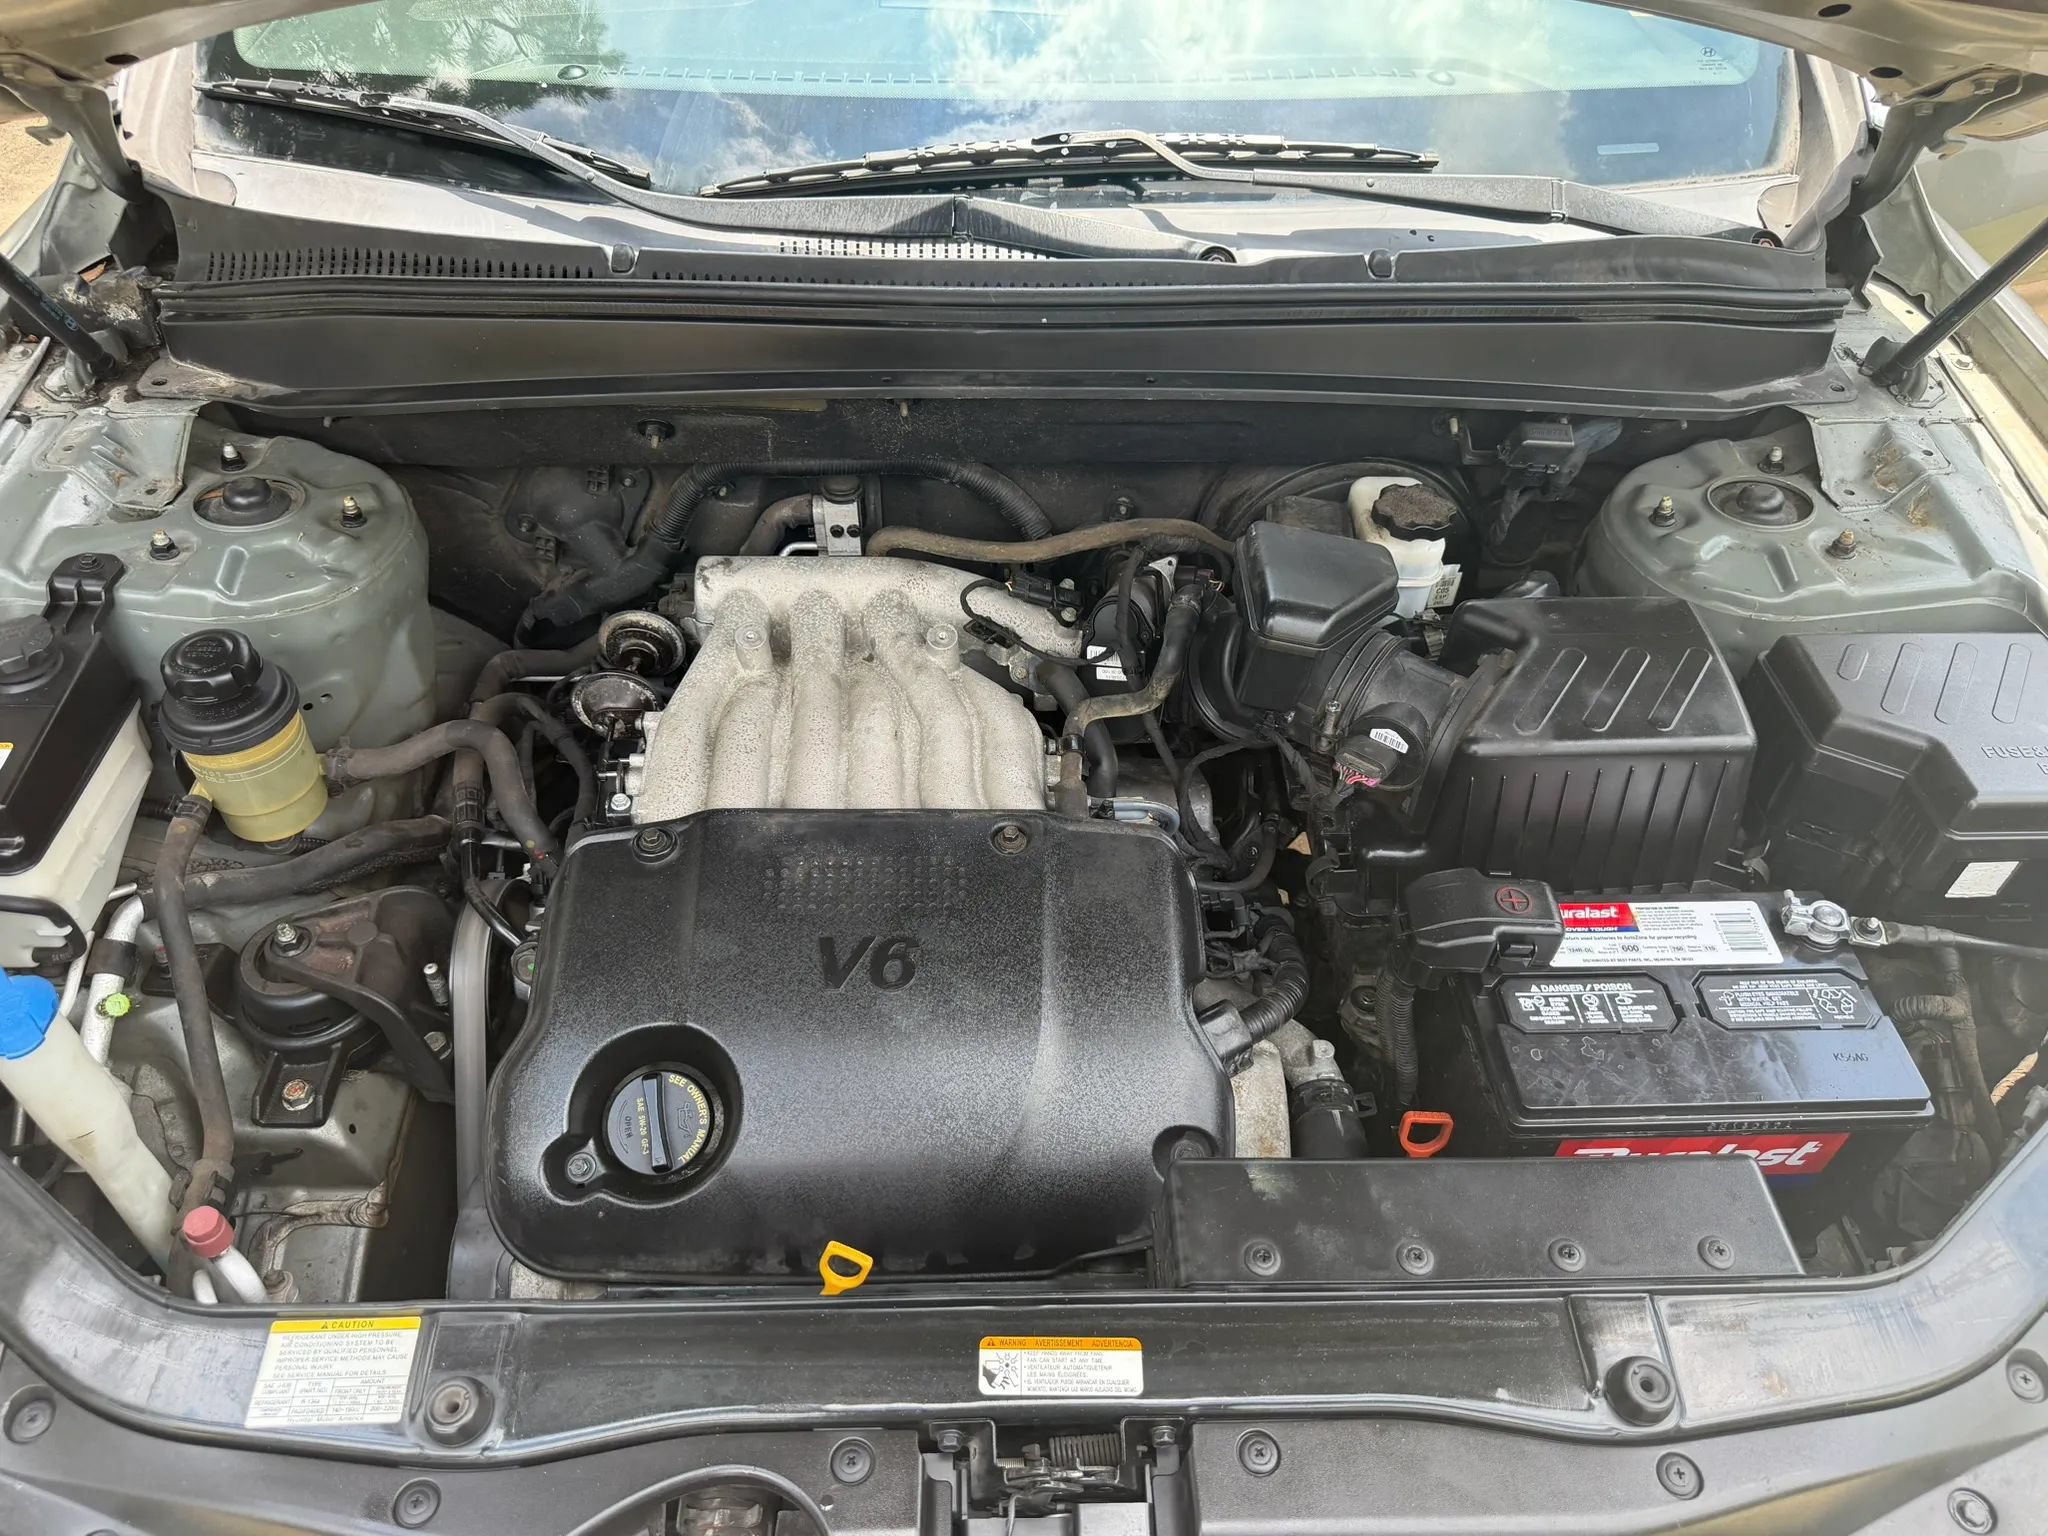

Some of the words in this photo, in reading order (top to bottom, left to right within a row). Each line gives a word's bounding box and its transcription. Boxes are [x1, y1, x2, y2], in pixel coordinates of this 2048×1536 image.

[1560, 906, 1618, 919] uralast
[819, 936, 917, 991] V6
[1593, 983, 1633, 991] POISON
[669, 1074, 687, 1087] SEE
[687, 1085, 708, 1124] OWNER'S
[624, 1116, 634, 1139] OPEN
[678, 1129, 706, 1163] MANUAL
[332, 1320, 374, 1329] CAUTION
